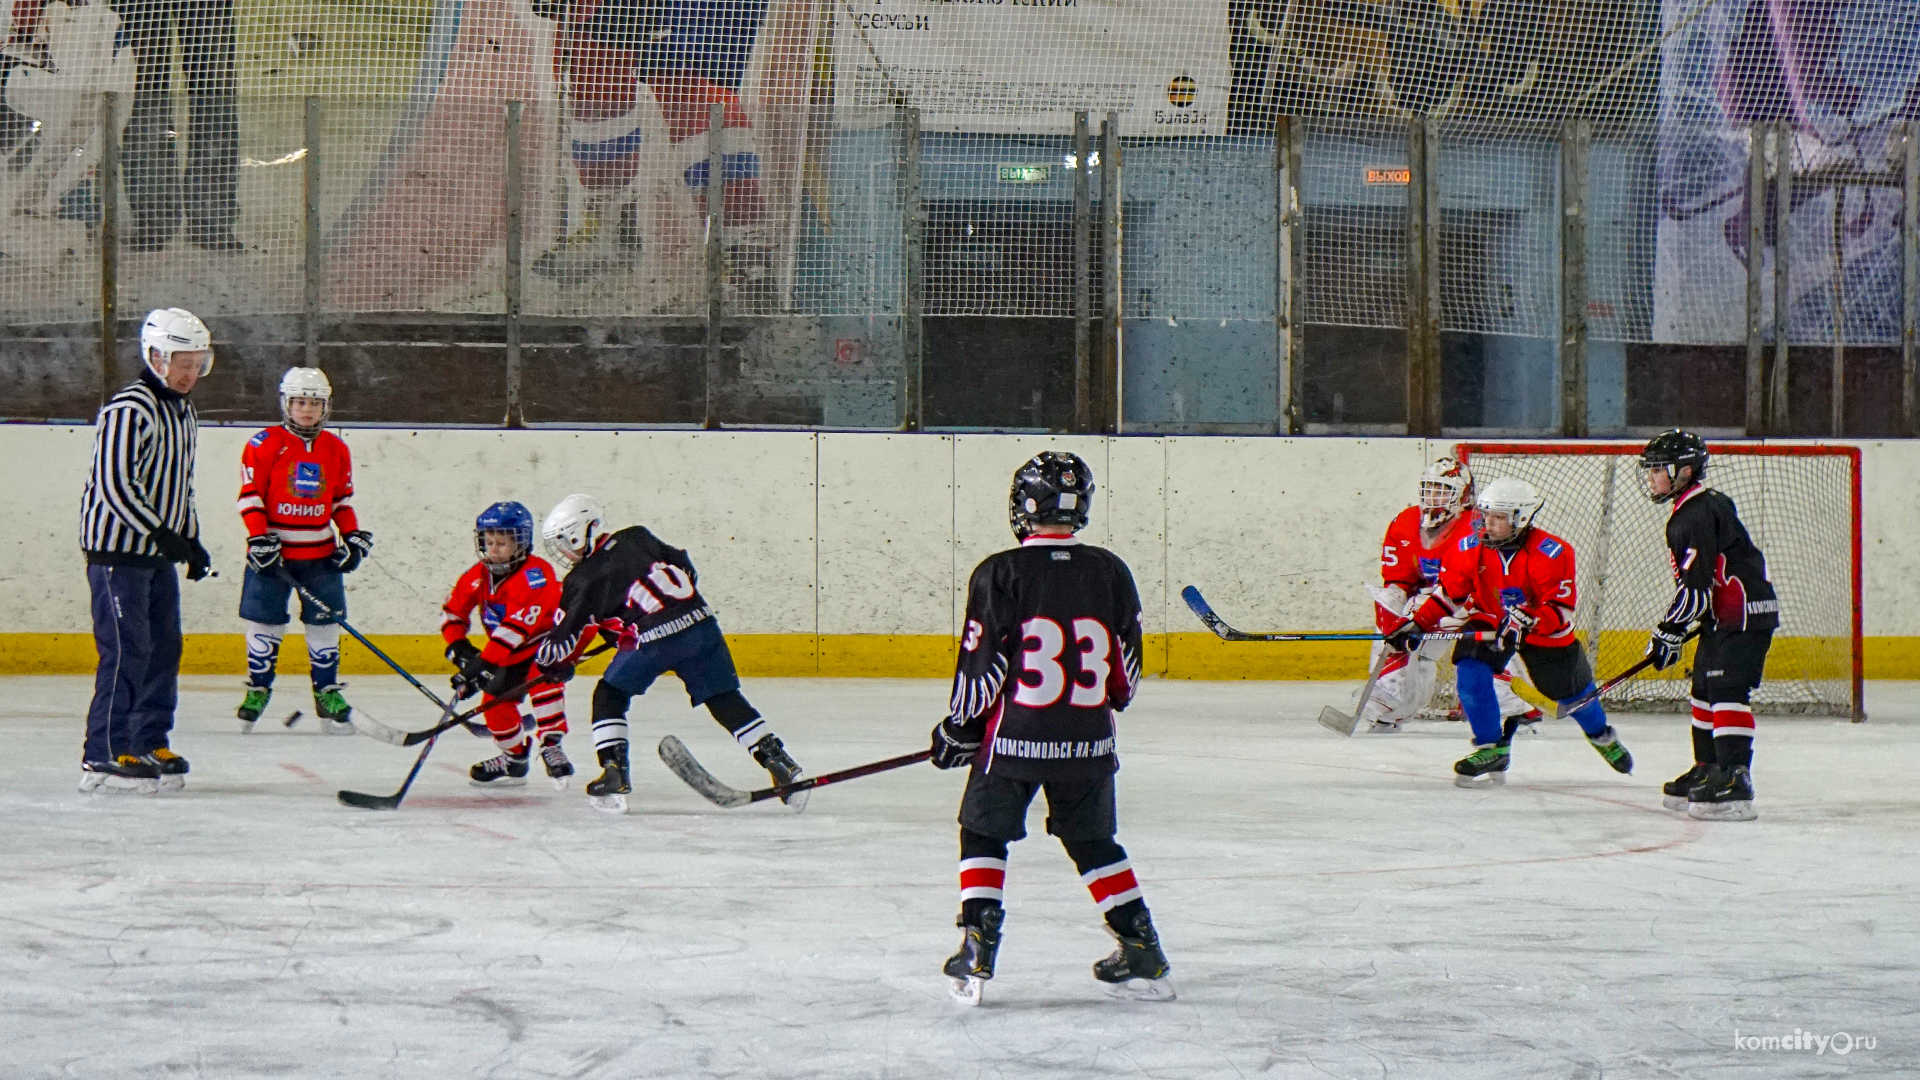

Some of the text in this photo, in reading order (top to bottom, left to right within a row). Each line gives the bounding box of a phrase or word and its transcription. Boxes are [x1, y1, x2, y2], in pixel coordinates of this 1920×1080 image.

[1001, 167, 1047, 180] ВЫХД
[1368, 170, 1411, 182] ВЫХОД
[277, 502, 325, 517] ЮНИОР
[1681, 547, 1698, 571] 7
[626, 561, 695, 615] 10
[1556, 579, 1573, 598] 5
[1422, 632, 1463, 641] BAUER
[1013, 616, 1112, 709] 33
